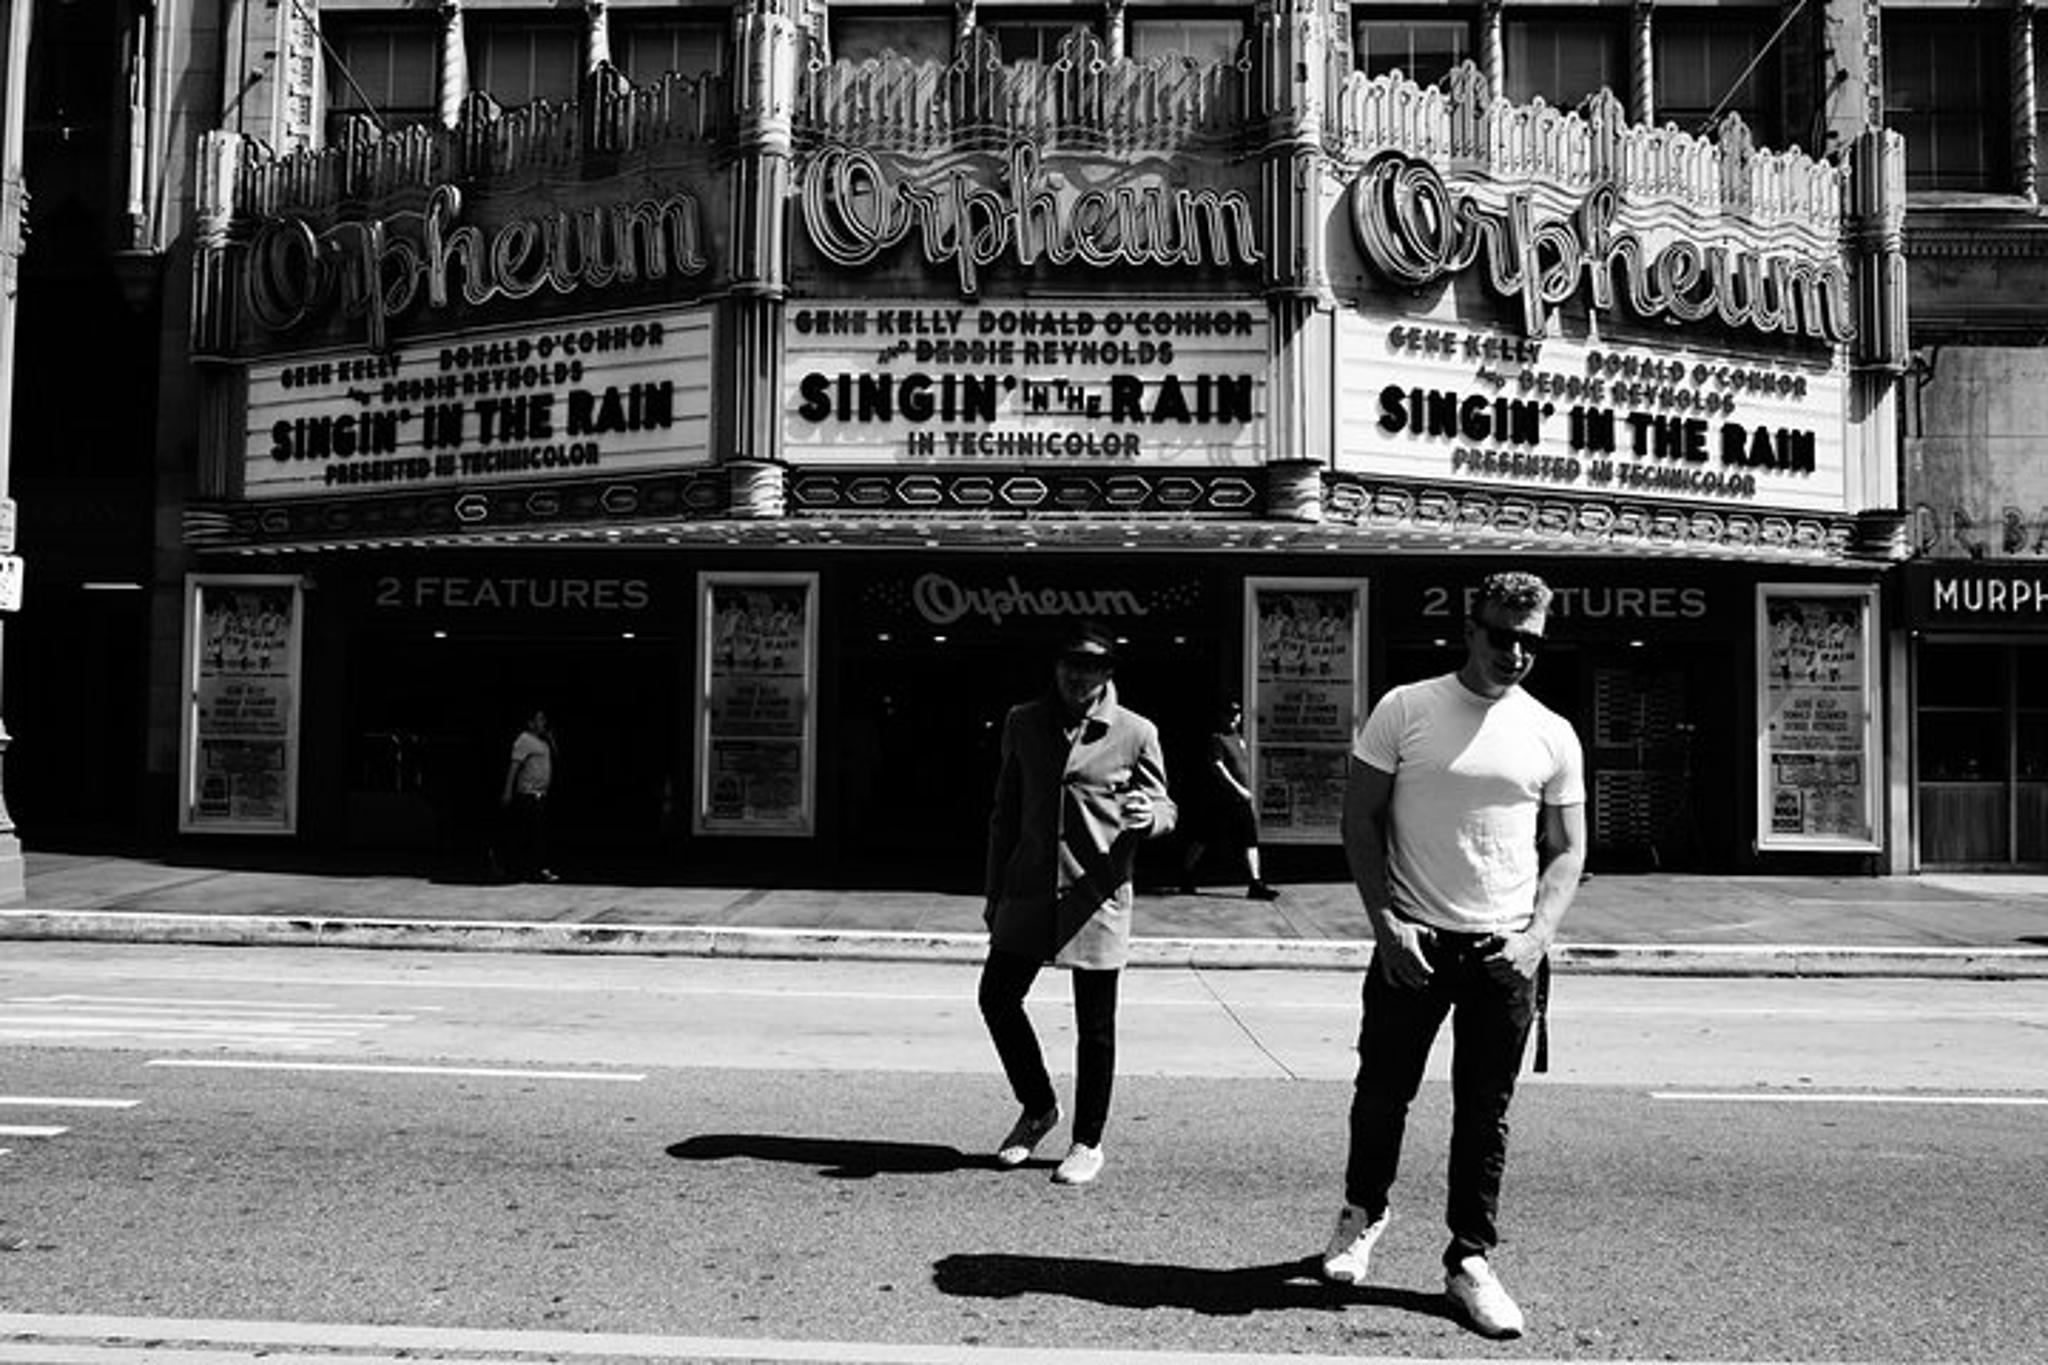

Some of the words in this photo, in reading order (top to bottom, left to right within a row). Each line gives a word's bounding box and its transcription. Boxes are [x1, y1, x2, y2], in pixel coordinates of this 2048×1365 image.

[802, 139, 1264, 293] Orpheum
[247, 185, 707, 350] Orpheum
[1353, 154, 1857, 341] Orpheum
[795, 310, 867, 334] GENE
[878, 310, 962, 334] KELLY
[979, 311, 1094, 336] DONALD
[1104, 311, 1252, 336] O'CONNOR
[281, 364, 331, 388] GENE
[338, 354, 401, 382] KELLY
[441, 340, 530, 371] DONALD
[538, 323, 663, 357] O'CONNOR
[916, 340, 1014, 364] DEBBIE
[1025, 341, 1174, 365] REYNOLDS
[1389, 325, 1457, 353] GENE
[1465, 335, 1542, 364] KELLY
[1587, 351, 1684, 382] DONALD
[1693, 364, 1807, 396] O'CONNOR
[383, 375, 456, 403] DEBBIE
[464, 360, 583, 394] REYNOLDS
[799, 373, 1016, 422] SINGIN'
[1022, 379, 1048, 411] IN
[1053, 379, 1101, 418] THE
[1112, 374, 1252, 423] RAIN
[1520, 370, 1603, 402] DEBBIE
[1612, 381, 1735, 414] REYNOLDS
[272, 409, 410, 461] SINGIN'
[424, 404, 463, 449] IN
[475, 393, 554, 445] THE
[568, 381, 673, 435] RAIN
[908, 432, 934, 455] IN
[946, 432, 1140, 455] TECHNICOLOR
[1379, 385, 1554, 445] SINGIN'
[1570, 405, 1614, 452] IN
[1629, 412, 1708, 461] THE
[1721, 422, 1815, 472] RAIN
[325, 458, 431, 485] PRESENTED
[461, 443, 599, 475] TECHNICOLOR
[1453, 447, 1580, 481] PRESENTED
[1588, 461, 1613, 481] IN
[1619, 463, 1755, 496] TECHNICOLOR
[376, 577, 401, 606] 2
[415, 578, 649, 608] FEATURES
[912, 573, 1149, 624] Orpheum
[1421, 587, 1450, 616] 2
[1463, 587, 1708, 618] FTURES
